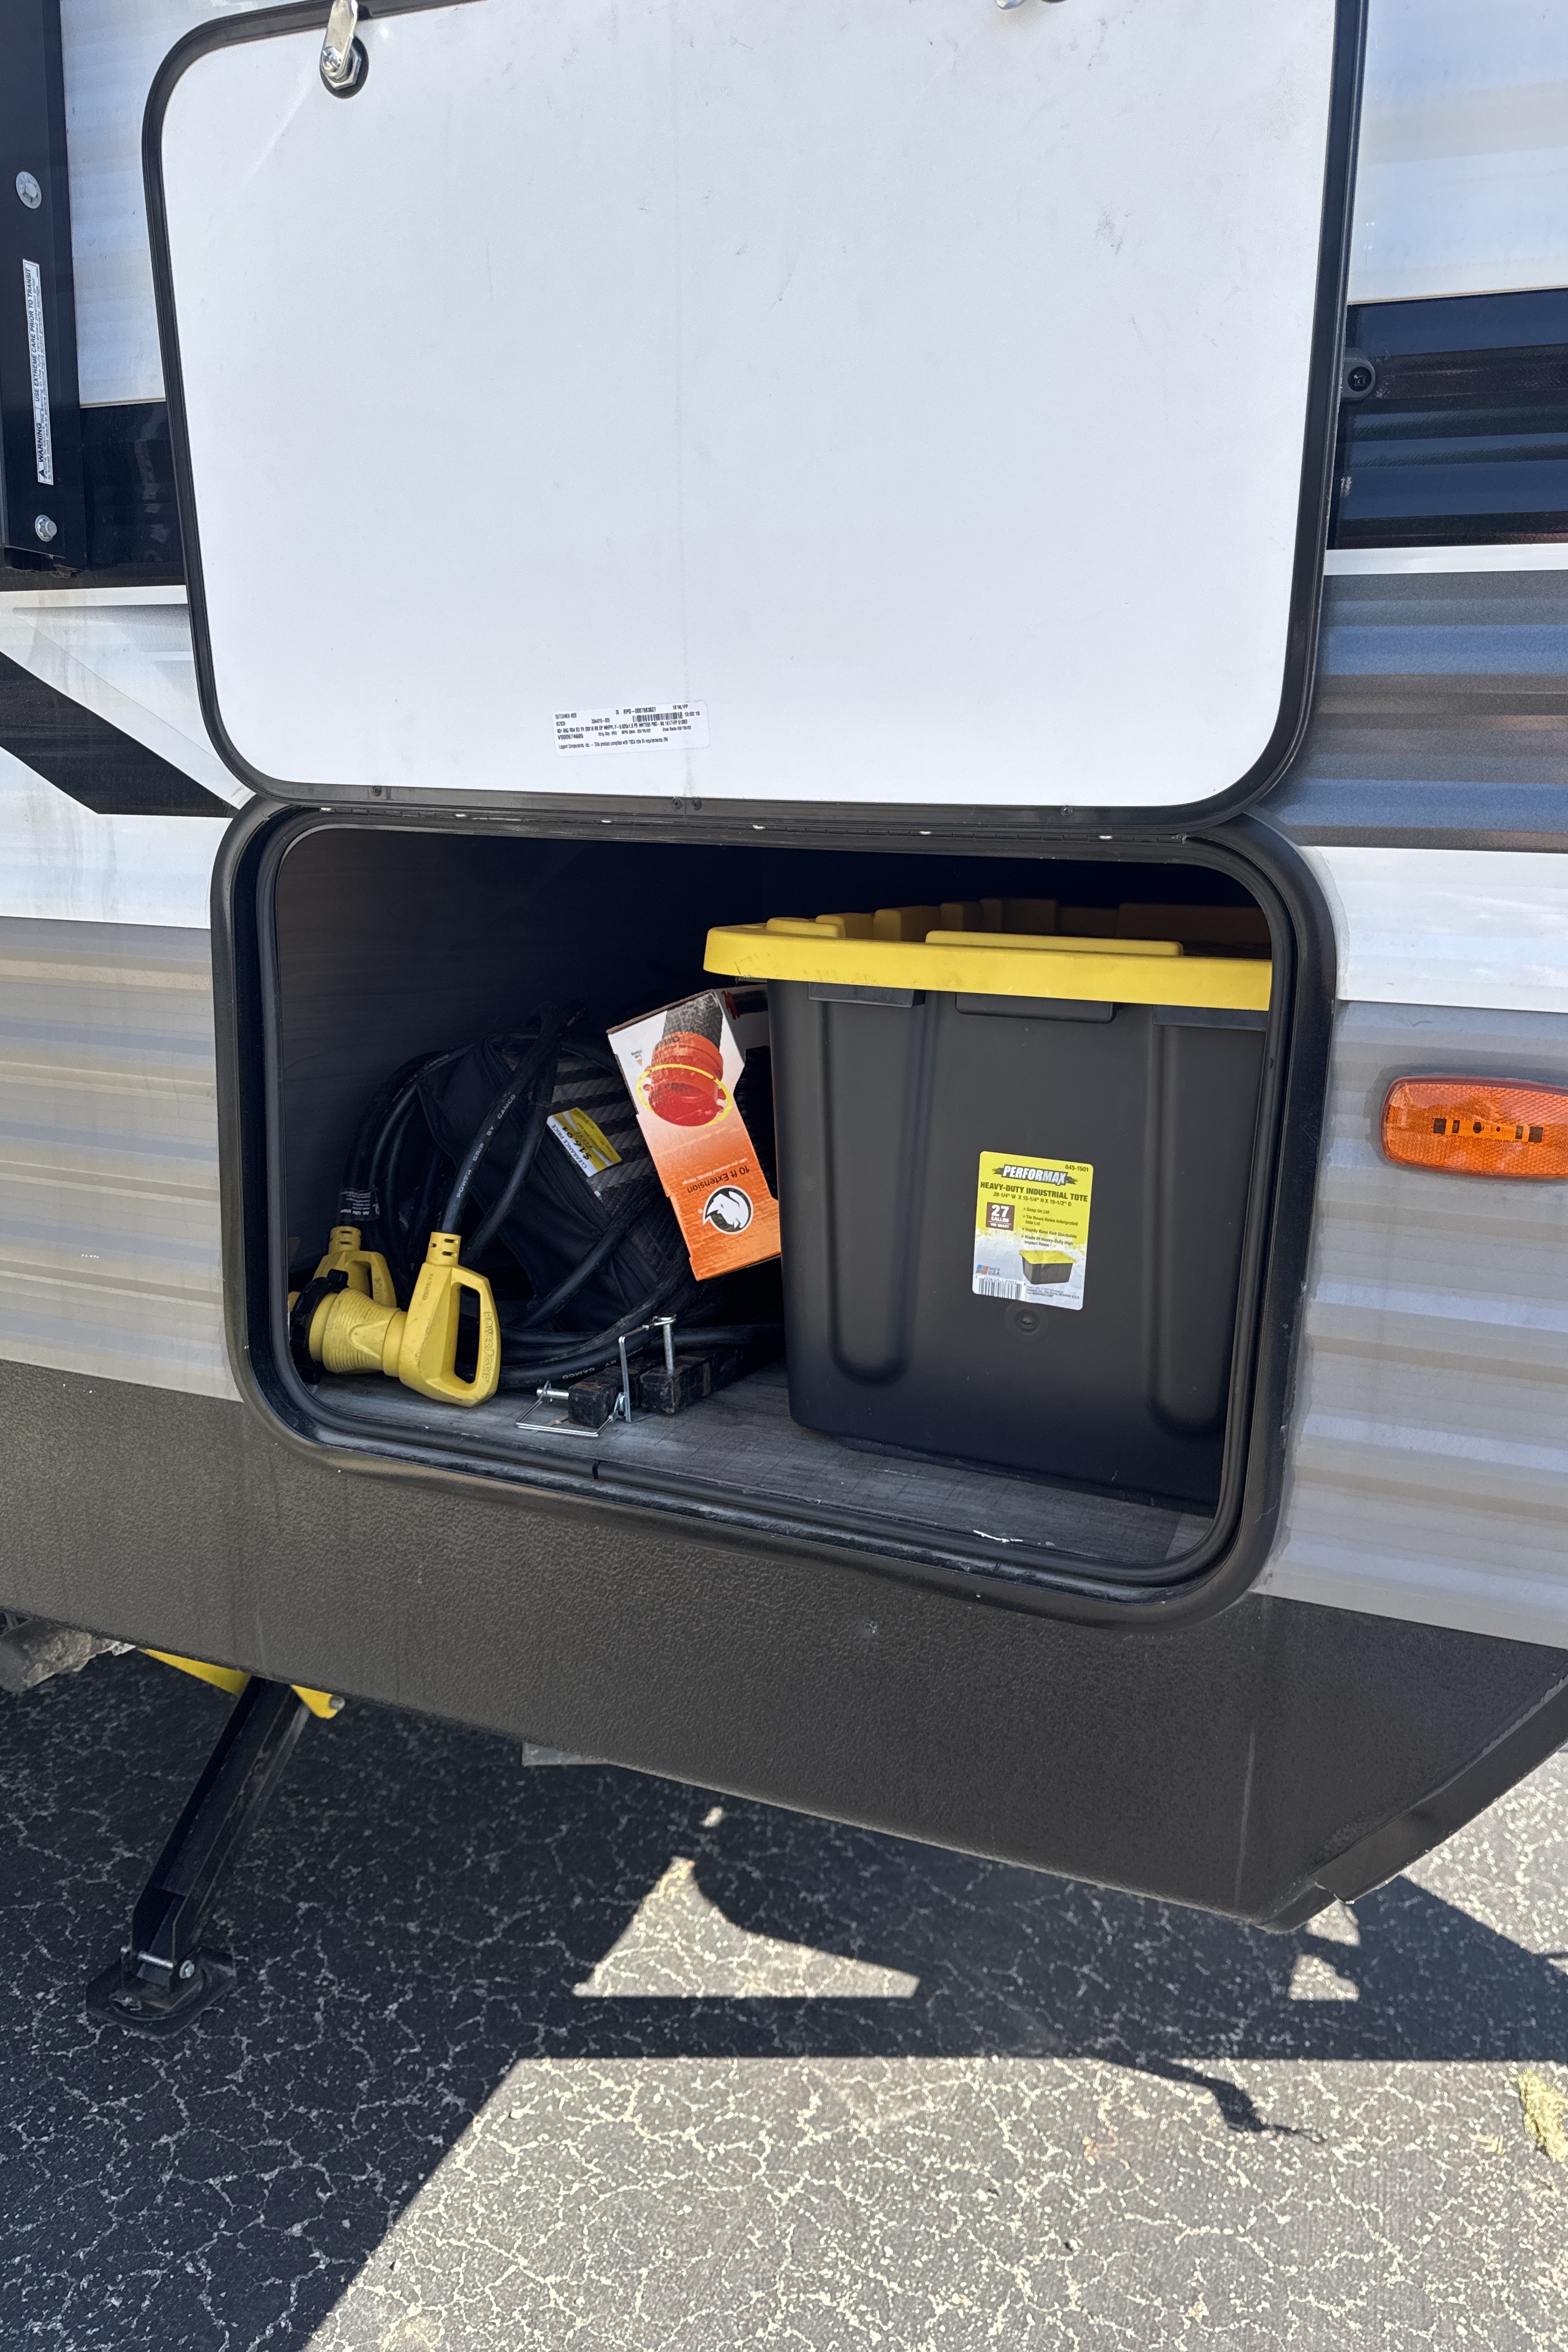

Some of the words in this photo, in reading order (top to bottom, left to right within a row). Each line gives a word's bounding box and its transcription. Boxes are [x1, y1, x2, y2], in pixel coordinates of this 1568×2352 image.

[29, 299, 33, 308] TO
[551, 1123, 565, 1140] PRICE
[456, 1169, 472, 1198] POWER
[473, 1143, 484, 1161] GRIP
[487, 1125, 494, 1136] BY
[497, 1094, 516, 1119] CAMCO
[562, 1139, 587, 1169] CLEARANCE
[729, 1169, 737, 1178] ft
[737, 1164, 750, 1175] 10
[1003, 1166, 1066, 1185] PERFORMAX
[687, 1173, 729, 1193] Extension
[980, 1181, 1024, 1193] HEAVY-DUTY
[1026, 1187, 1068, 1199] INDUSTRIAL
[1070, 1194, 1088, 1202] TOTE
[991, 1204, 1009, 1217] 27
[481, 1311, 494, 1348] POWER
[481, 1356, 492, 1381] GRIP
[562, 1367, 595, 1380] CAMCO
